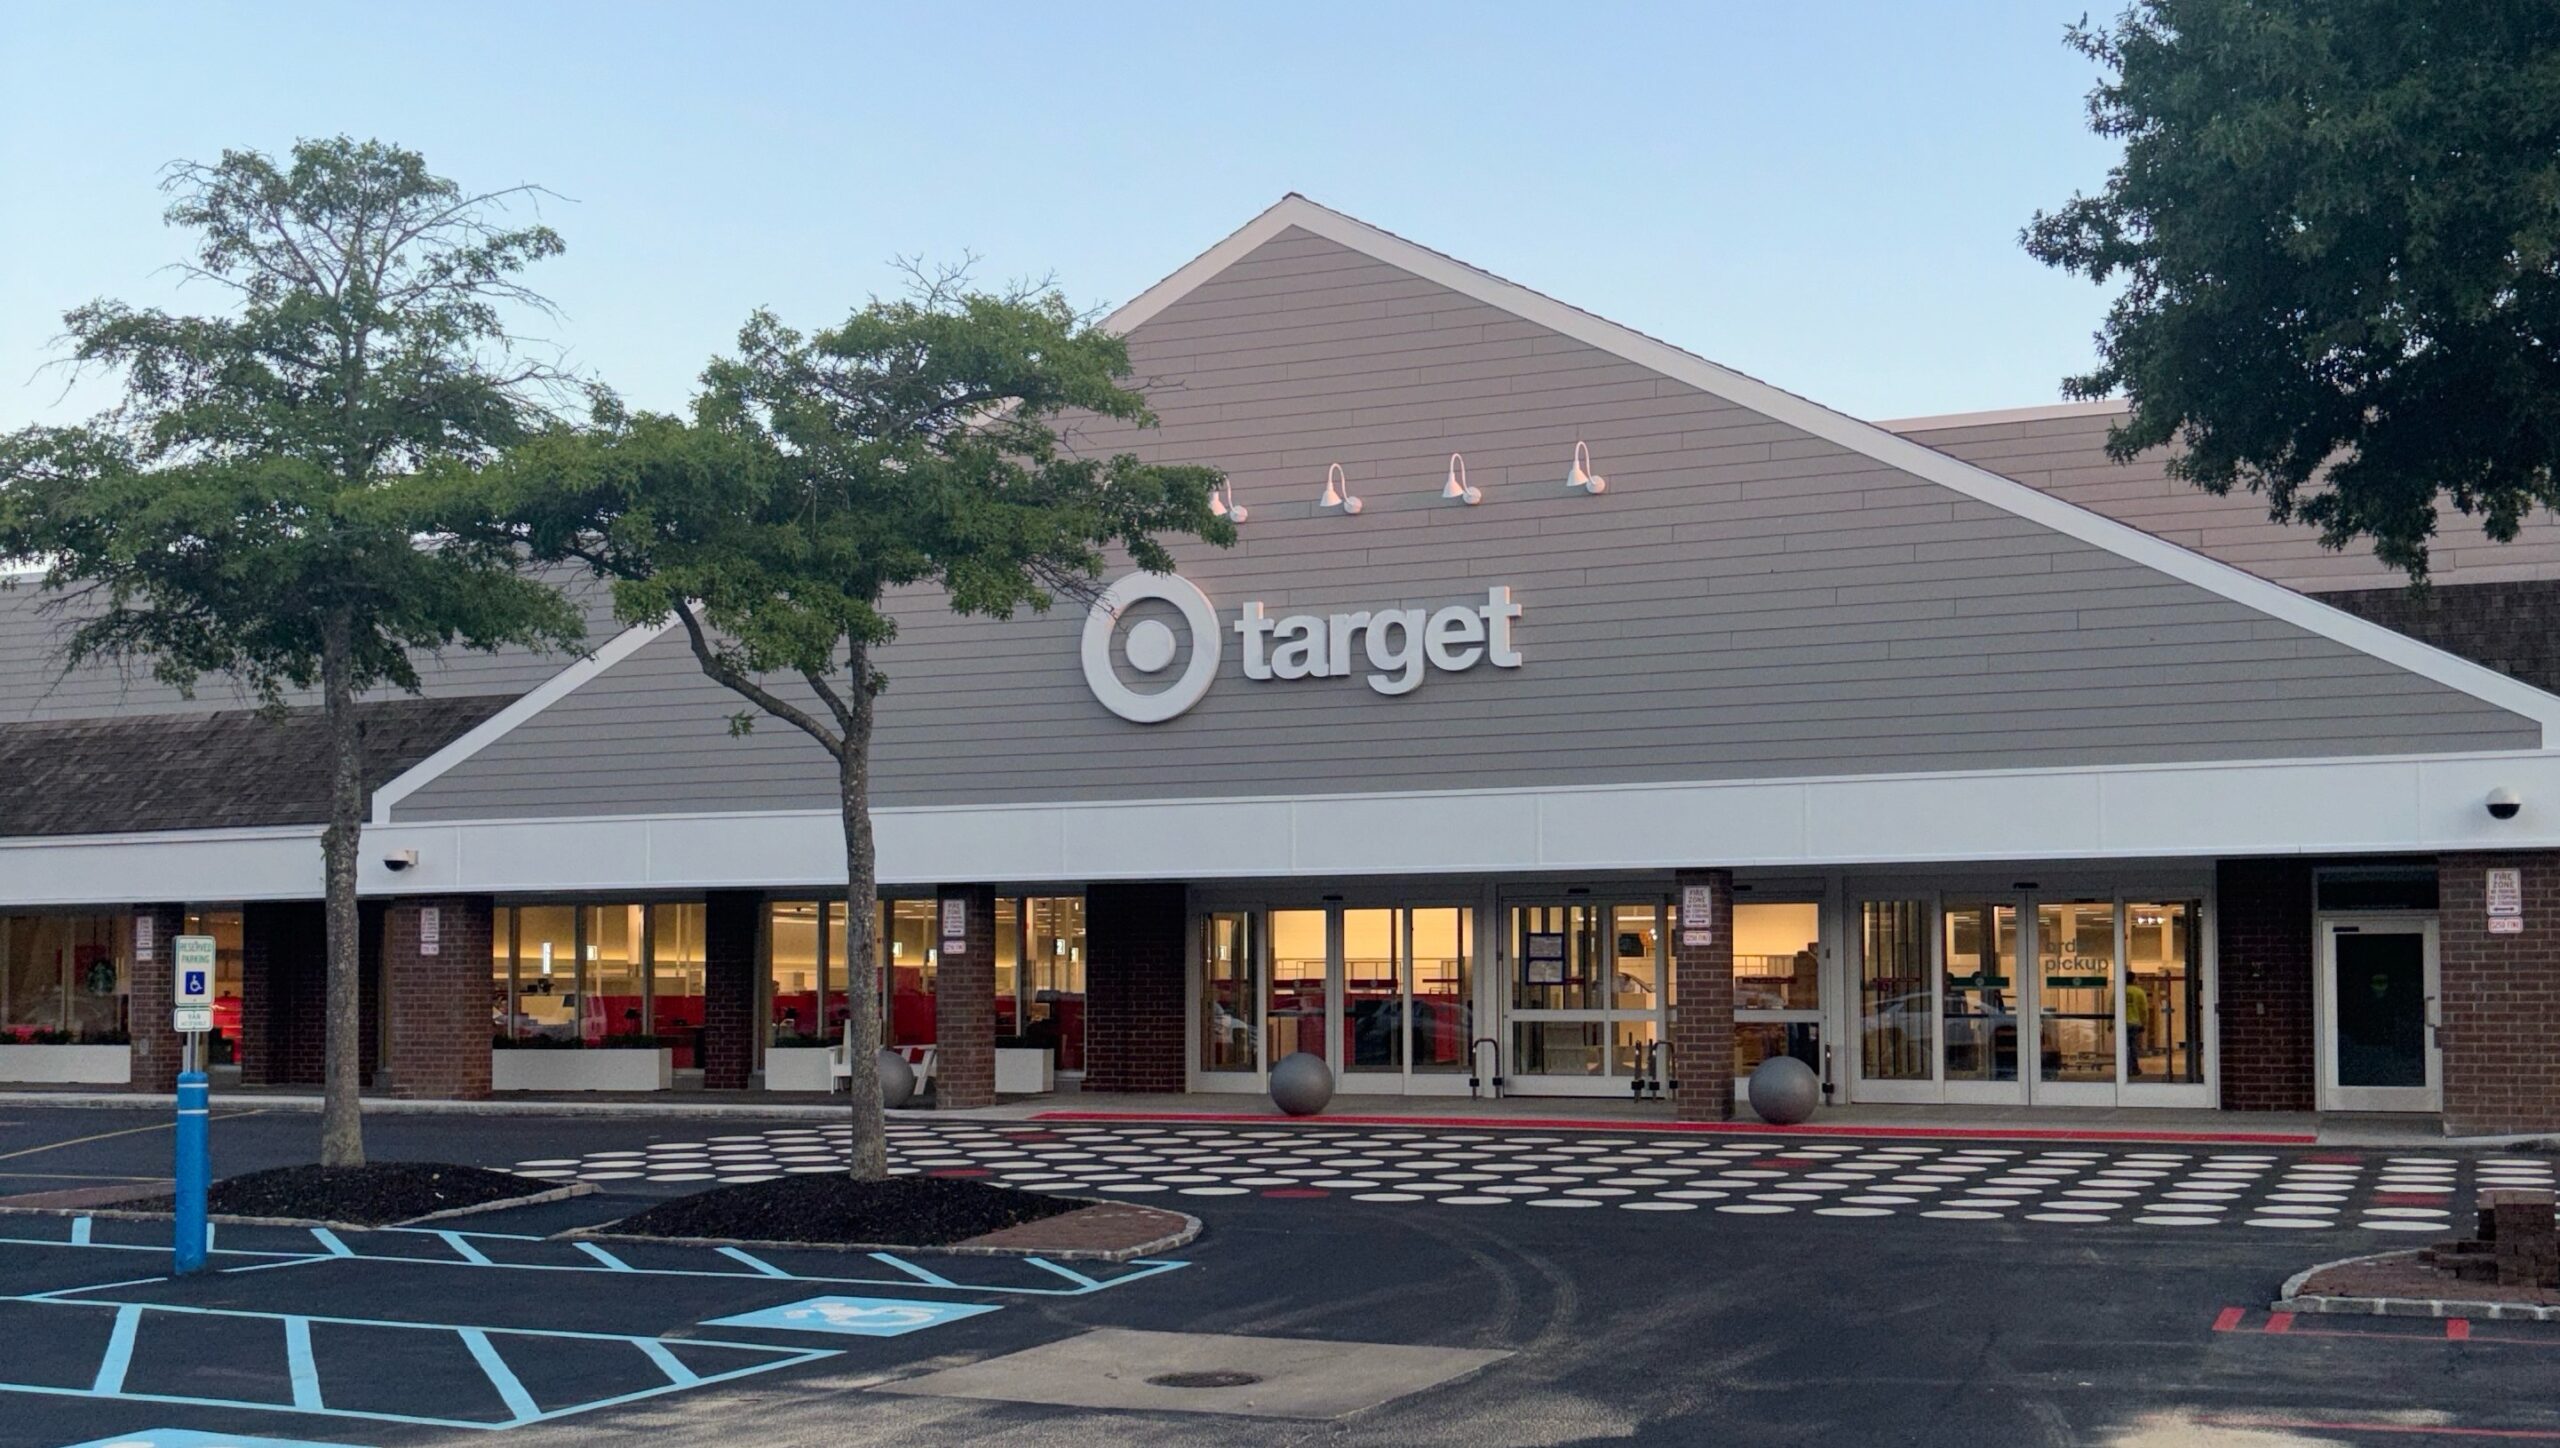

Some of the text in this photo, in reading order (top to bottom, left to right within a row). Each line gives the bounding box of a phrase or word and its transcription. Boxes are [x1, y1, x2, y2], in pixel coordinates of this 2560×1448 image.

[1234, 586, 1522, 695] target
[2494, 872, 2512, 880] FIRE
[2493, 881, 2514, 889] ZONE
[179, 942, 213, 952] RESERVED
[182, 954, 210, 963] PARKING
[2045, 956, 2108, 973] pickup
